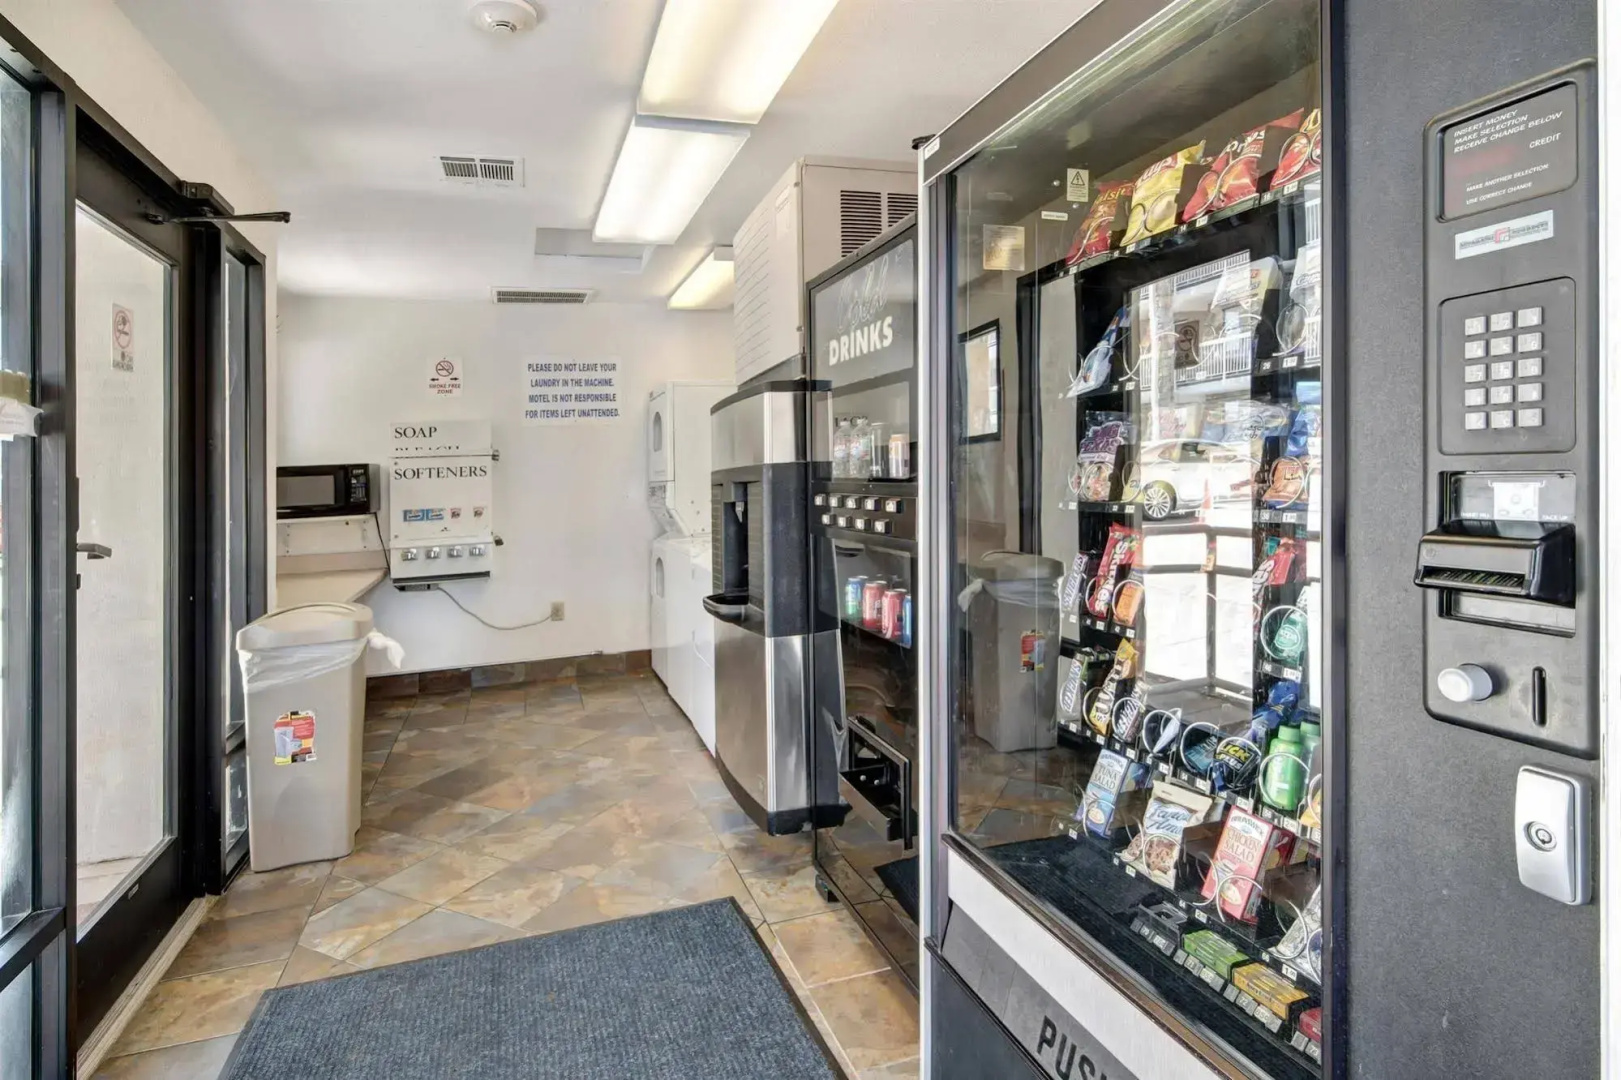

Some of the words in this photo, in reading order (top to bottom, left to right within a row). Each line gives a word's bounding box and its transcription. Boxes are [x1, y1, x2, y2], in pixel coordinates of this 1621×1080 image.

[1454, 121, 1484, 138] INSERT
[1486, 110, 1518, 126] MONEY
[1454, 132, 1479, 146] MAKE
[1480, 115, 1528, 138] SELECTION
[1454, 137, 1489, 154] RECEIVE
[1490, 125, 1526, 142] CHANGE
[1528, 111, 1563, 128] BELOW
[1529, 132, 1562, 149] CREDIT
[1466, 183, 1483, 192] MAKE
[1484, 174, 1513, 188] ANOTHER
[1513, 163, 1549, 180] SELECTION
[1479, 189, 1507, 202] CORRECT
[1507, 181, 1533, 194] CHANGE
[829, 316, 893, 366] DRINKS
[528, 363, 552, 372] PLEASE
[553, 363, 563, 372] DO
[564, 363, 577, 372] NOT
[578, 363, 598, 372] LEAVE
[600, 363, 617, 372] YOUR
[531, 379, 560, 387] LAUNDRY
[562, 379, 569, 387] IN
[570, 378, 583, 387] THE
[584, 378, 614, 387] MACHINE.
[529, 394, 550, 403] MOTEL
[552, 394, 558, 403] IS
[560, 394, 573, 403] NOT
[574, 393, 616, 402] RESPONSIBLE
[525, 410, 538, 419] FOR
[540, 409, 559, 418] ITEMS
[561, 409, 576, 418] LEFT
[577, 408, 620, 418] UNATTENDED.
[394, 427, 437, 439] SOAP
[394, 466, 487, 480] SOFTENERS
[1223, 838, 1255, 864] SALAD
[1227, 830, 1259, 852] CHICKEN
[1036, 1014, 1109, 1080] PUS
